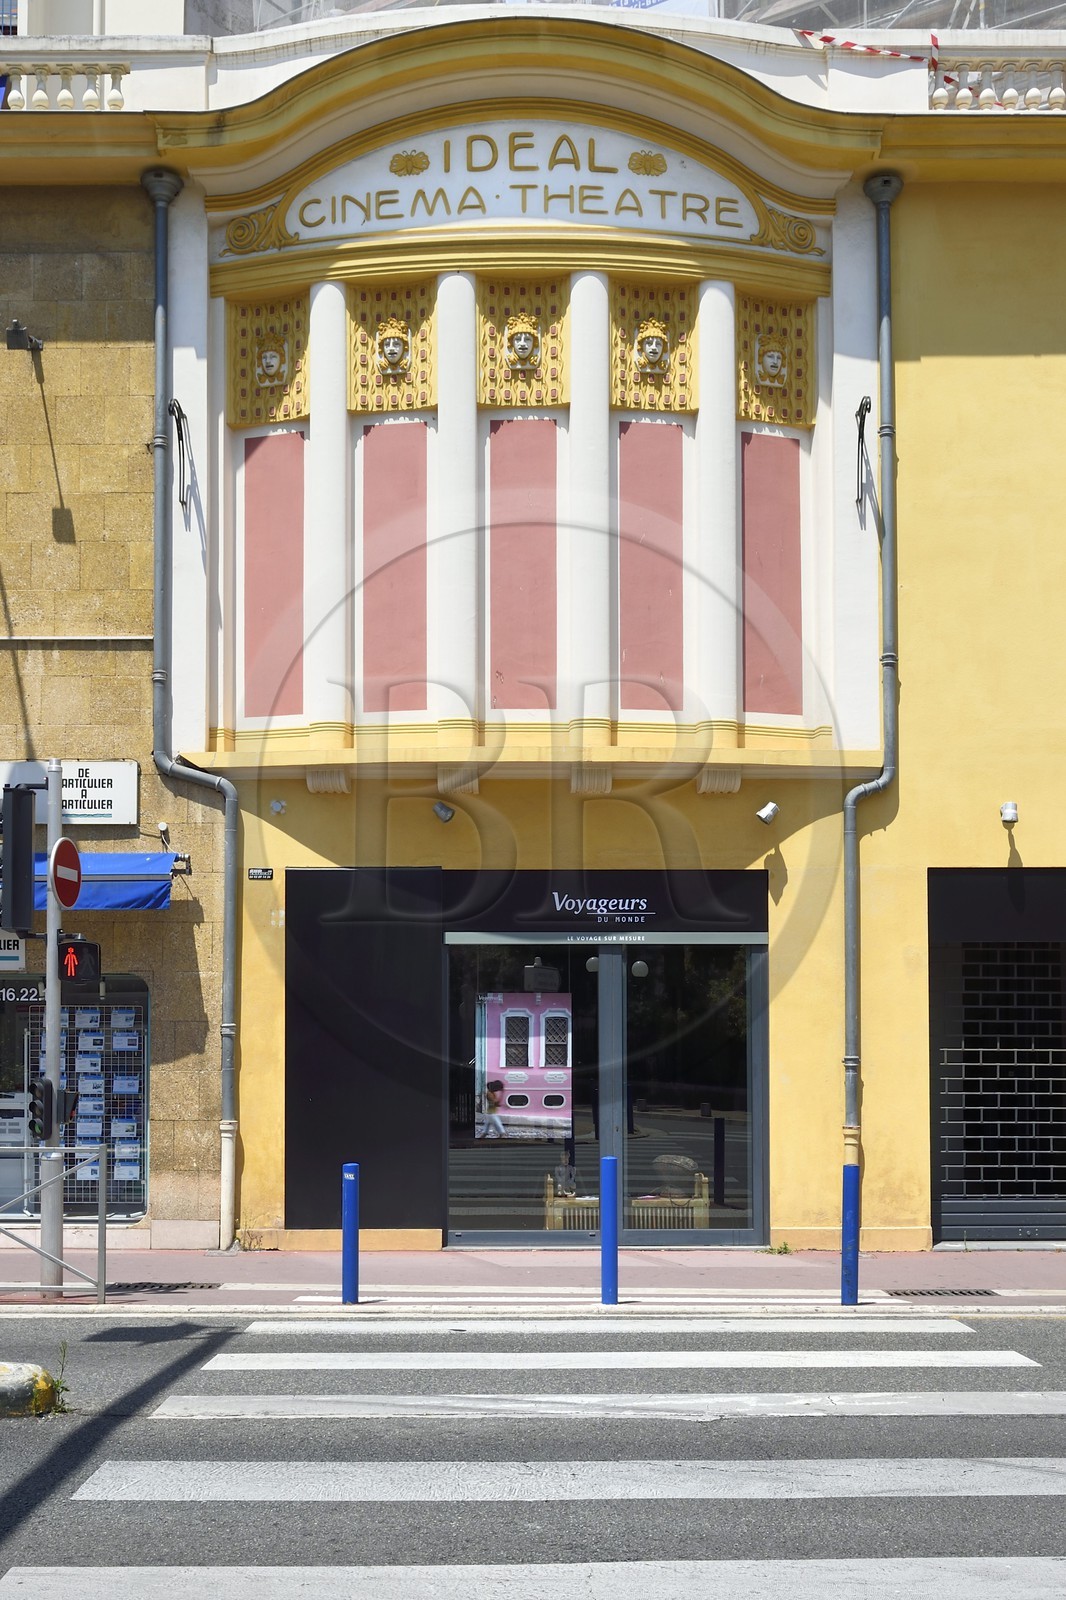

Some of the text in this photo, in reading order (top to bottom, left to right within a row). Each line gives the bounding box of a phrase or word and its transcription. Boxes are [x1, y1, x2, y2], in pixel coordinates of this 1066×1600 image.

[443, 131, 619, 174] IDEAL
[298, 183, 743, 229] CINEMA THEATRE
[78, 768, 90, 778] DE
[61, 778, 113, 789] ARTICULIER
[81, 789, 87, 799] A
[61, 799, 113, 810] ARTICULIER
[552, 891, 648, 915] Voyageurs
